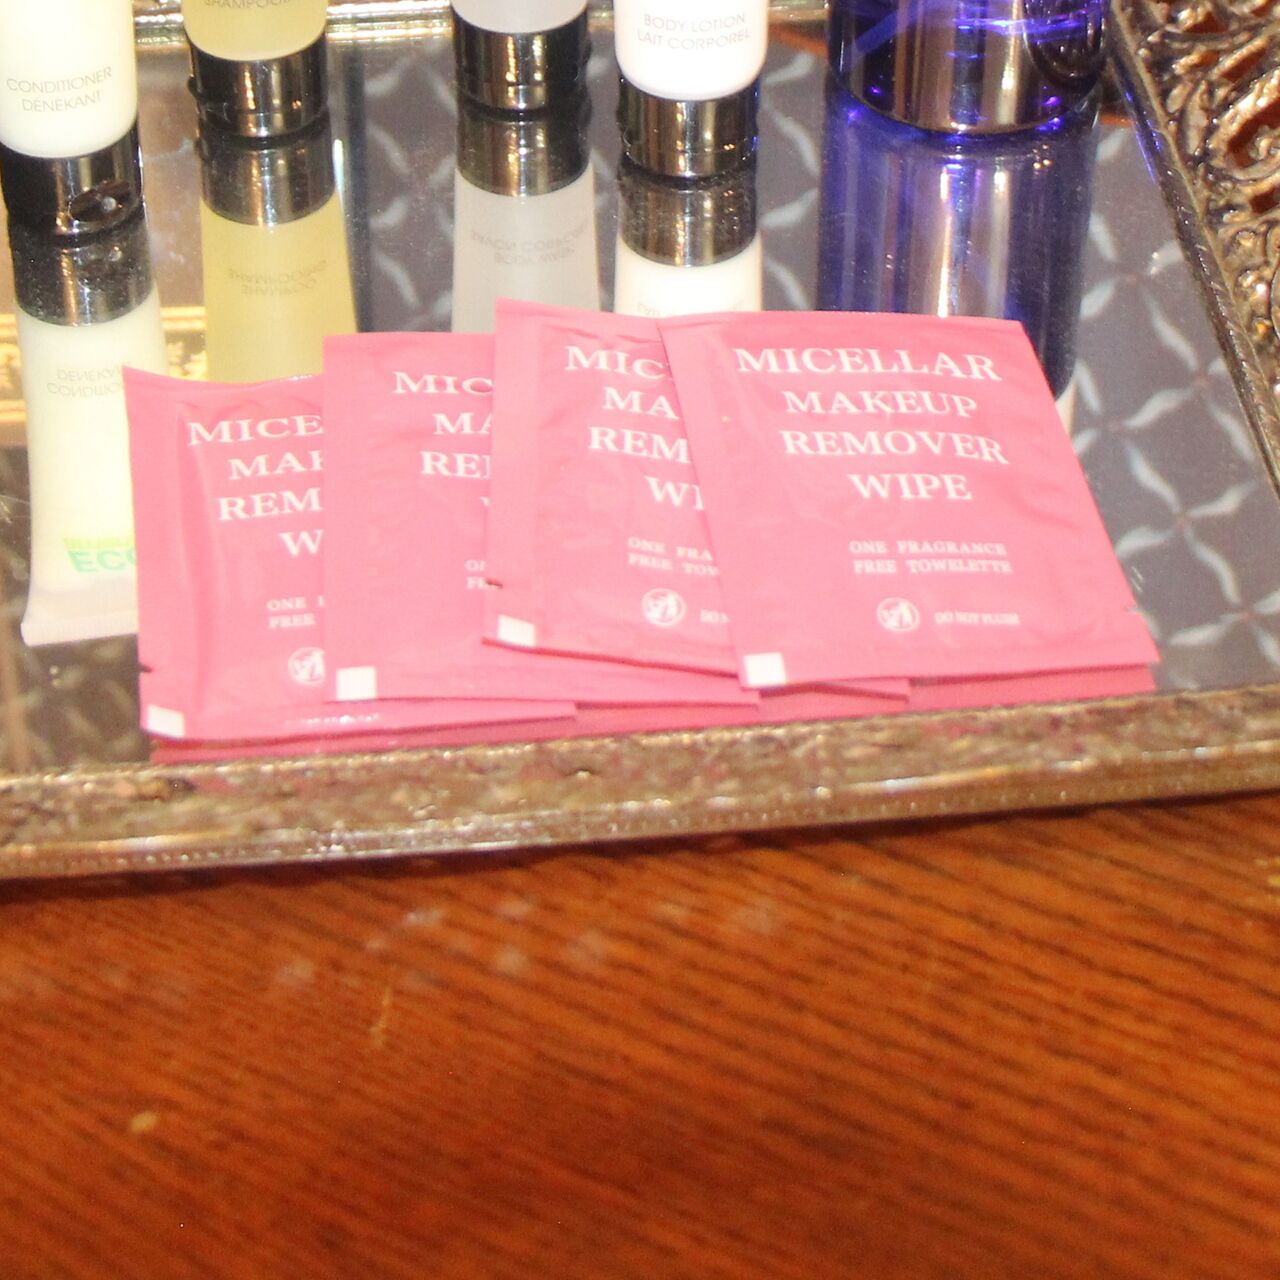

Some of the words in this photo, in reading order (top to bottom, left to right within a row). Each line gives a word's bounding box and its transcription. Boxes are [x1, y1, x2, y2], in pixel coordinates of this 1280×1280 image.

[644, 13, 686, 32] BODY
[6, 66, 112, 94] CONDITIONER
[565, 346, 672, 381] MIC
[732, 348, 1003, 381] MICELLAR
[781, 390, 977, 418] MAKEUP
[778, 430, 1011, 465] REMOVER
[847, 473, 973, 500] WIPE
[627, 537, 666, 554] ONE
[849, 540, 887, 554] ONE
[896, 540, 1008, 556] FRAGRANCE
[853, 559, 897, 574] FREE
[906, 559, 1014, 574] TOWELETTE
[267, 596, 307, 611] ONE
[269, 613, 316, 629] FREE
